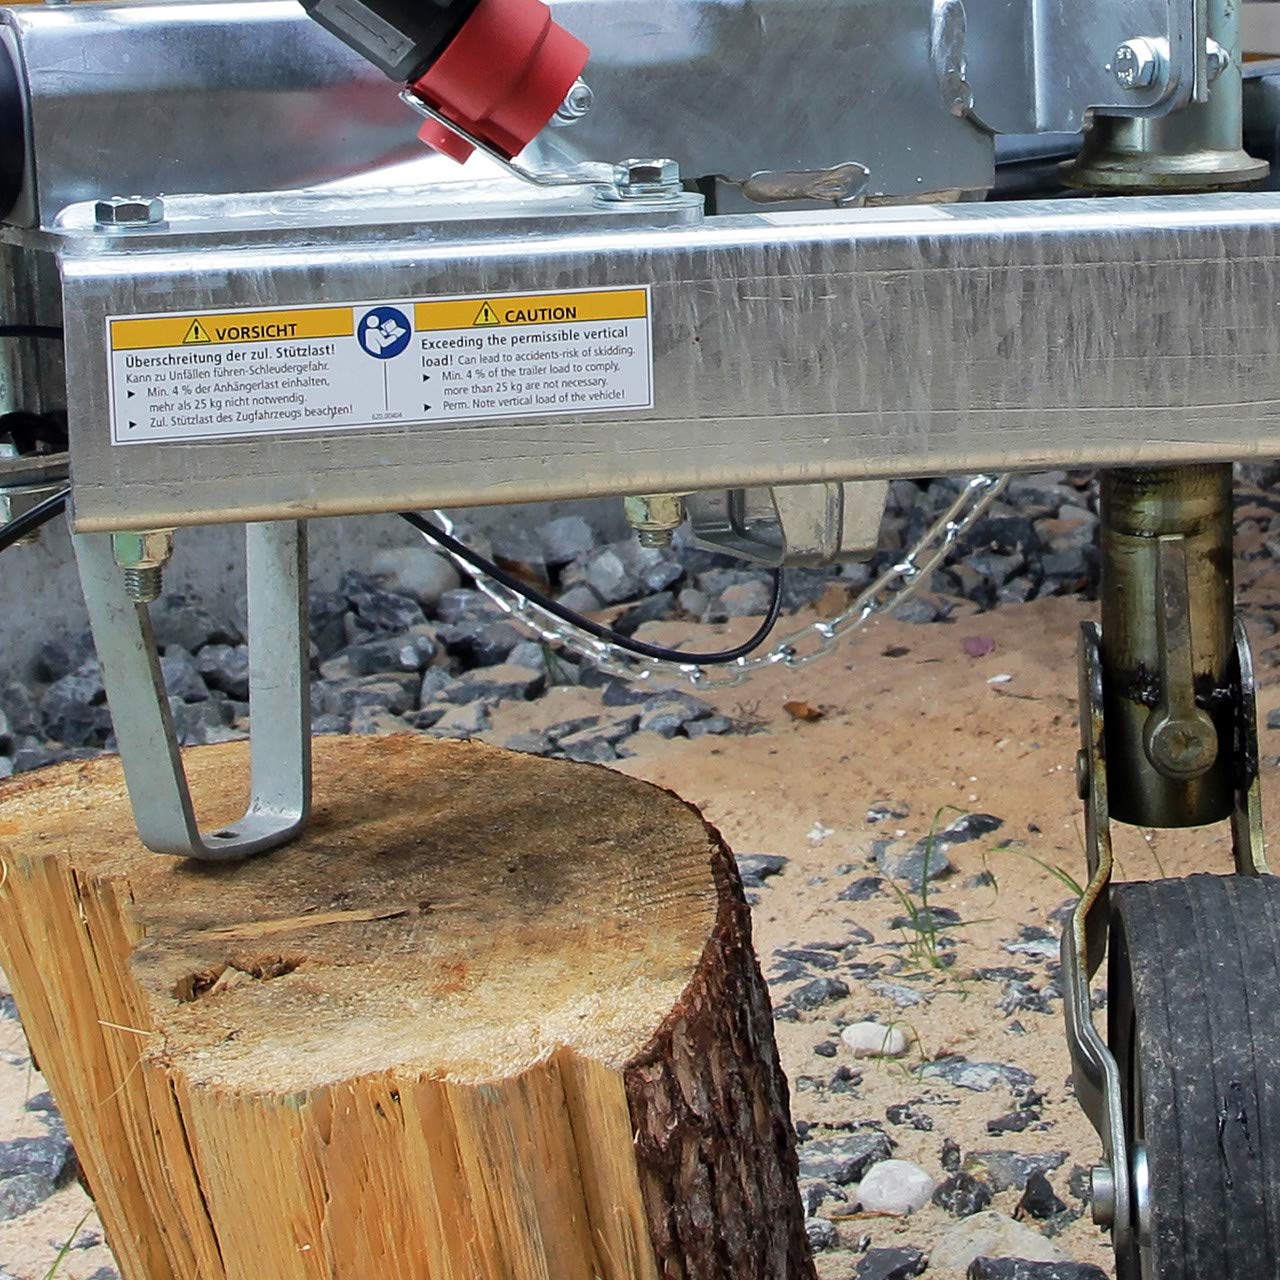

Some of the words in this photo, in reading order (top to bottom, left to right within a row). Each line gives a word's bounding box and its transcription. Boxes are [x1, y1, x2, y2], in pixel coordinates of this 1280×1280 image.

[504, 306, 577, 323] CAUTION
[215, 324, 298, 340] VORSICHT
[421, 336, 483, 350] Exceeding
[487, 334, 507, 346] the
[511, 329, 580, 347] permissible
[583, 326, 628, 340] vertical
[125, 353, 222, 368] Überschreitung
[226, 350, 247, 362] der
[251, 347, 273, 360] zul.
[276, 344, 335, 359] Stützlast!
[422, 354, 453, 367] load!
[458, 355, 477, 365] Can
[479, 353, 500, 364] lead
[502, 352, 513, 362] to
[515, 348, 579, 362] accidents-risk
[581, 347, 592, 357] of
[594, 345, 636, 357] skidding.
[126, 374, 152, 384] Kann
[154, 374, 166, 382] zu
[169, 369, 211, 381] Unfällen
[441, 371, 464, 381] Min.
[466, 369, 473, 379] 4
[474, 369, 486, 379] %
[488, 367, 499, 378] of
[501, 367, 517, 377] the
[519, 365, 547, 376] trailer
[549, 363, 570, 375] load
[573, 364, 583, 373] to
[147, 387, 169, 397] Min.
[172, 385, 179, 395] 4
[181, 384, 192, 395] %
[195, 383, 211, 394] der
[213, 379, 280, 394] Anhängerlast
[443, 386, 469, 396] more
[471, 384, 493, 394] than
[495, 382, 508, 393] 25
[510, 381, 523, 394] kg
[525, 381, 541, 391] are
[543, 379, 559, 389] not
[149, 402, 175, 413] mehr
[177, 400, 192, 411] als
[194, 399, 207, 410] 25
[210, 398, 222, 411] kg
[225, 396, 250, 407] nicht
[252, 393, 308, 405] notwendig.
[443, 400, 470, 411] Perm.
[472, 398, 496, 409] Note
[497, 395, 533, 407] vertical
[535, 392, 556, 404] load
[558, 391, 569, 403] of
[570, 391, 587, 402] the
[589, 389, 625, 401] vehicle!
[150, 417, 168, 428] Zul.
[171, 414, 214, 427] Stützlast
[216, 412, 233, 423] des
[236, 409, 302, 424] Zugfahrzeugs
